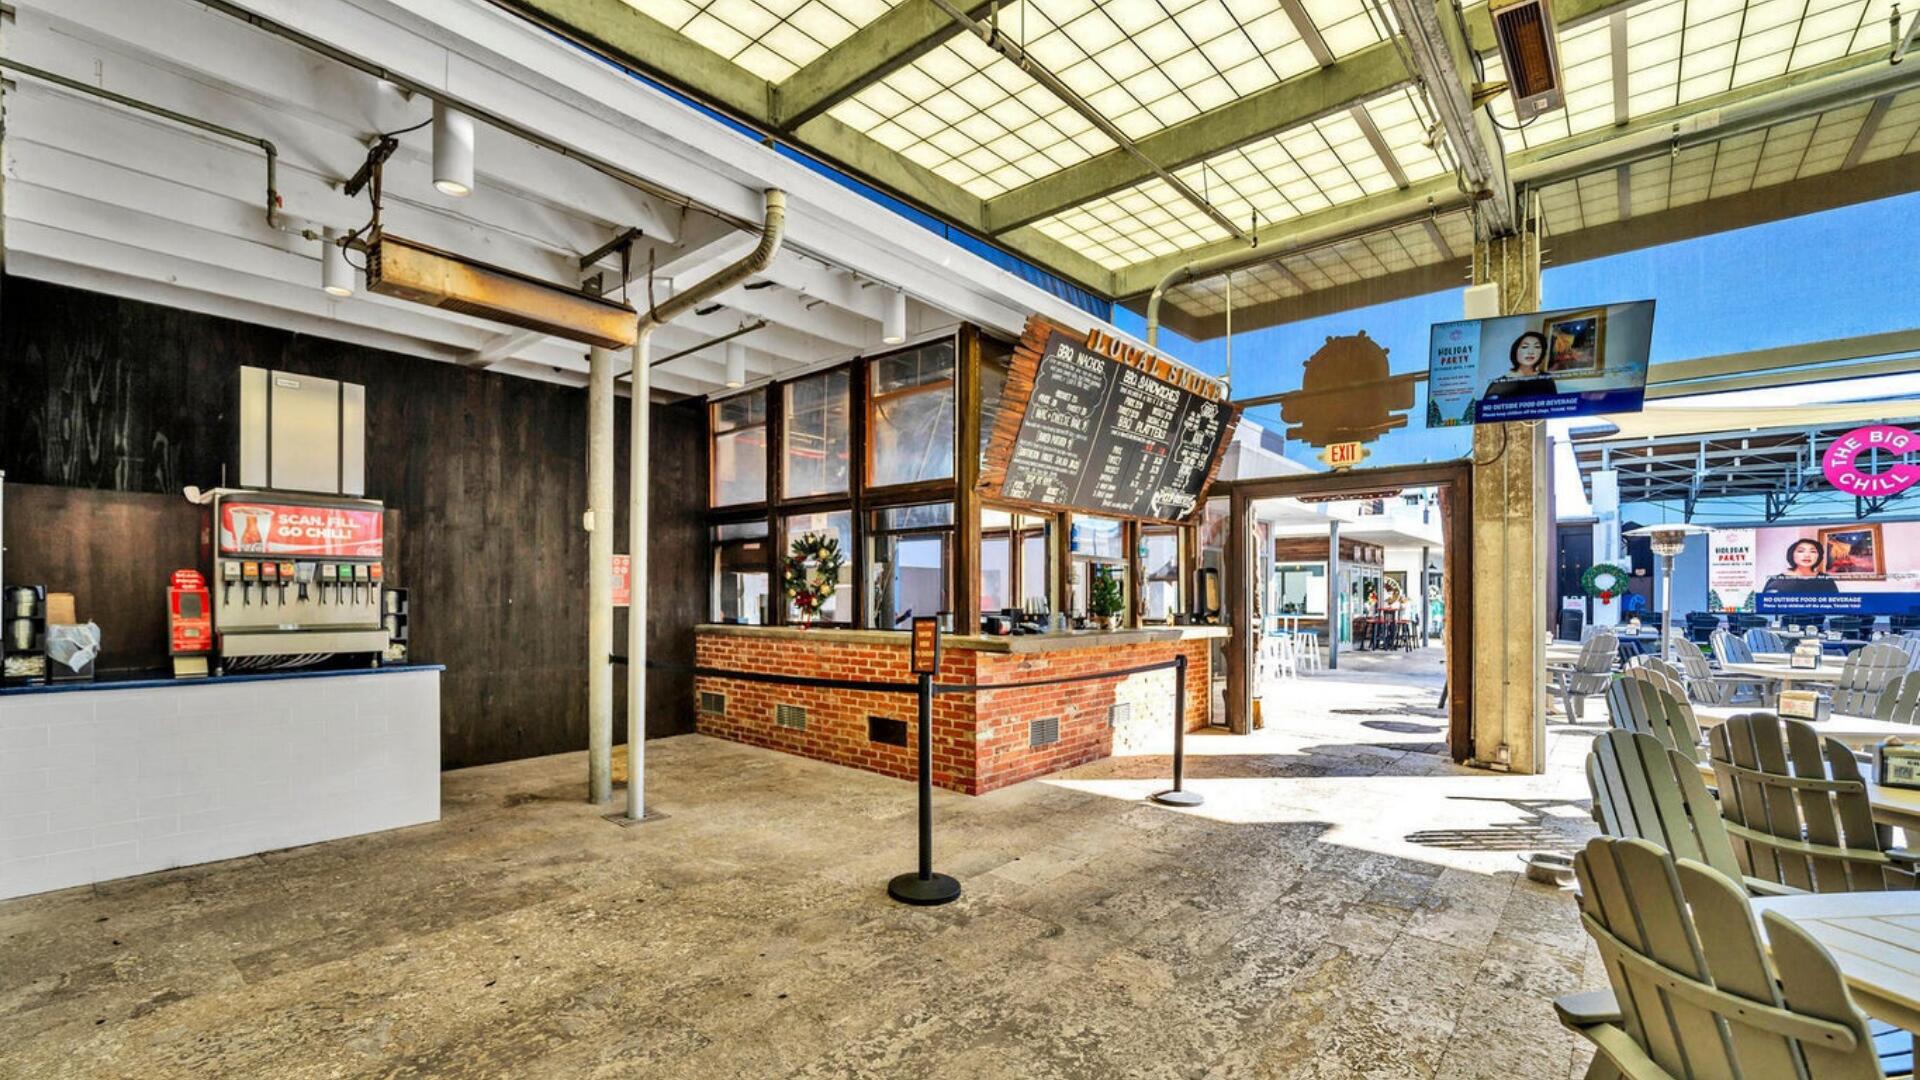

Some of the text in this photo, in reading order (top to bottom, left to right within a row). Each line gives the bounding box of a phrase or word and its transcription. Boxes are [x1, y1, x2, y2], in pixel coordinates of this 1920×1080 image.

[1056, 343, 1105, 373] BBQ NACHOS
[1438, 345, 1473, 356] HOLIDAY
[1095, 330, 1160, 376] LOCAL
[1168, 364, 1222, 402] SMOKE
[1440, 354, 1470, 366] PARTY
[1124, 370, 1138, 386] BBQ
[1138, 375, 1181, 403] SANDWICHES
[1493, 402, 1518, 410] OUTSIDE
[1546, 398, 1578, 406] BEVERAGE
[1118, 416, 1132, 430] BBQ
[1135, 420, 1167, 440] PLATTERS
[1332, 444, 1356, 462] EXIT
[1831, 431, 1909, 468] THE BIG
[1839, 472, 1910, 491] CHILL
[278, 514, 360, 528] SCAN. FILL.
[278, 526, 352, 539] GO CHILL!
[1716, 546, 1749, 554] HOLIDAY
[1718, 554, 1746, 562] PARTY
